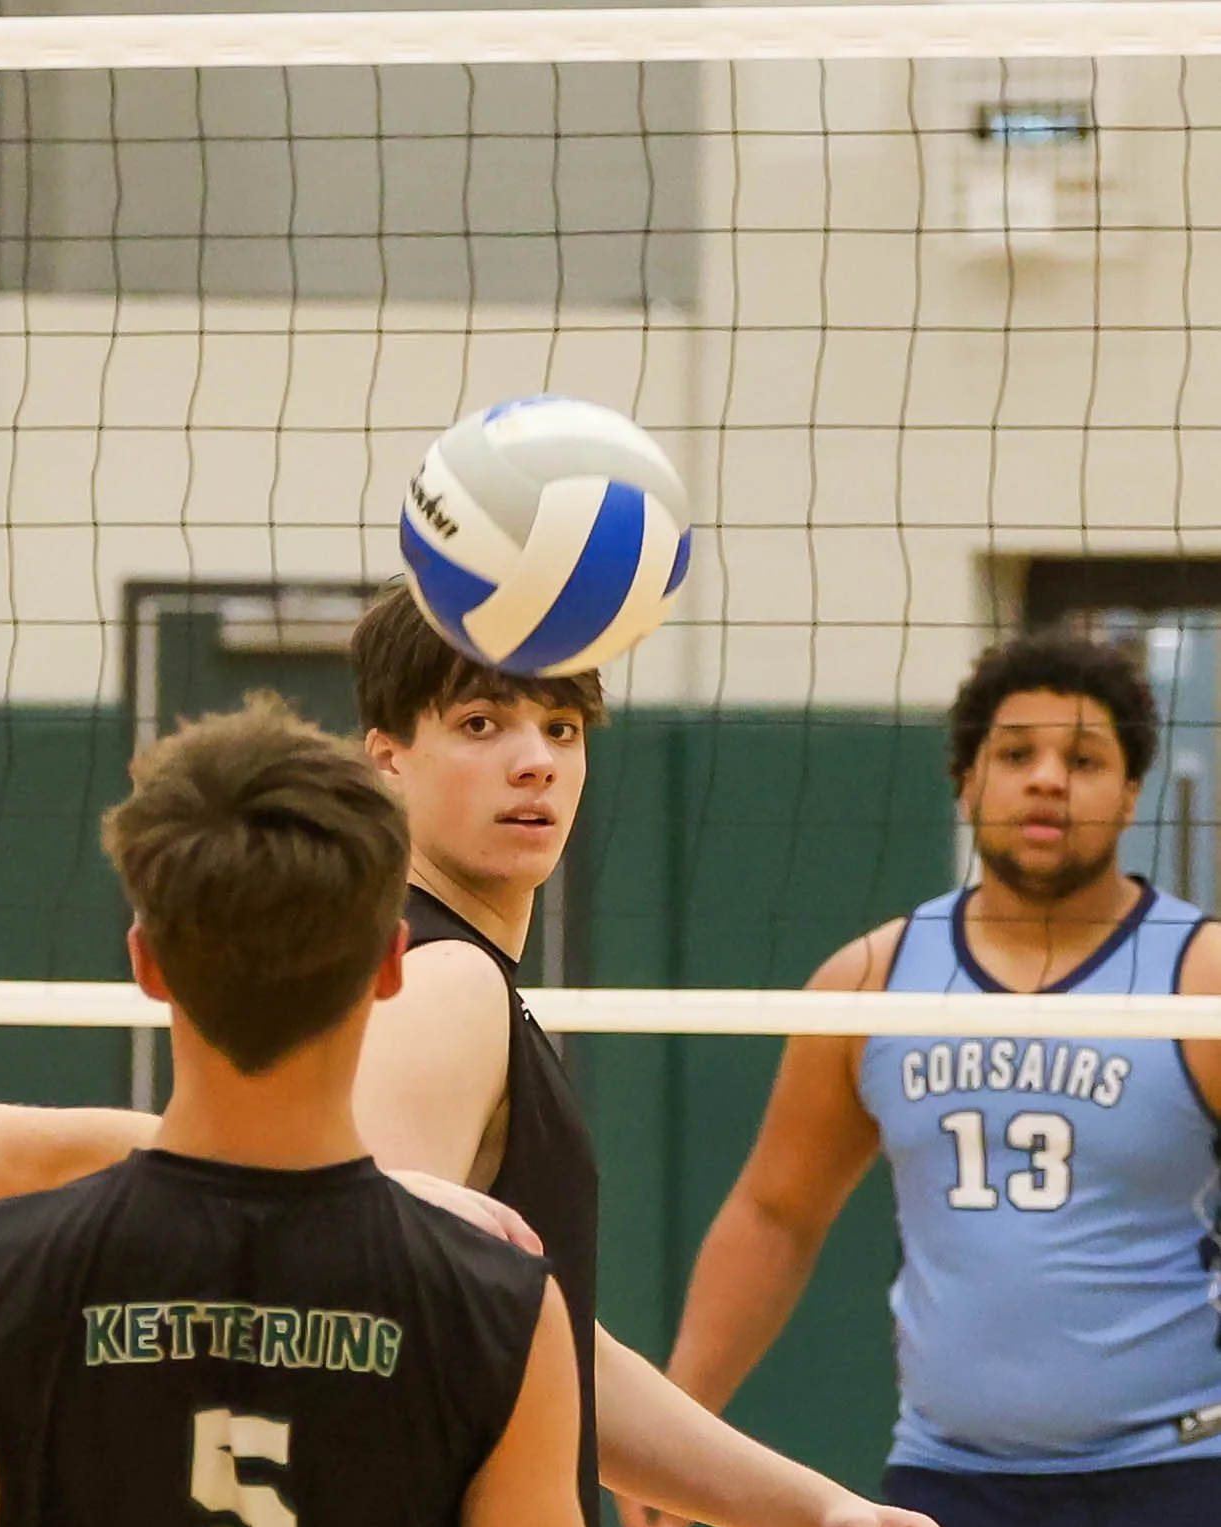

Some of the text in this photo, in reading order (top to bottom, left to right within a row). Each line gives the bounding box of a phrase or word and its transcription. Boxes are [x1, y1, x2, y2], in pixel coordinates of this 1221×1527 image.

[902, 1038, 1130, 1107] CORSAIRS
[940, 1110, 1074, 1211] 13
[82, 1302, 402, 1377] KETTERING
